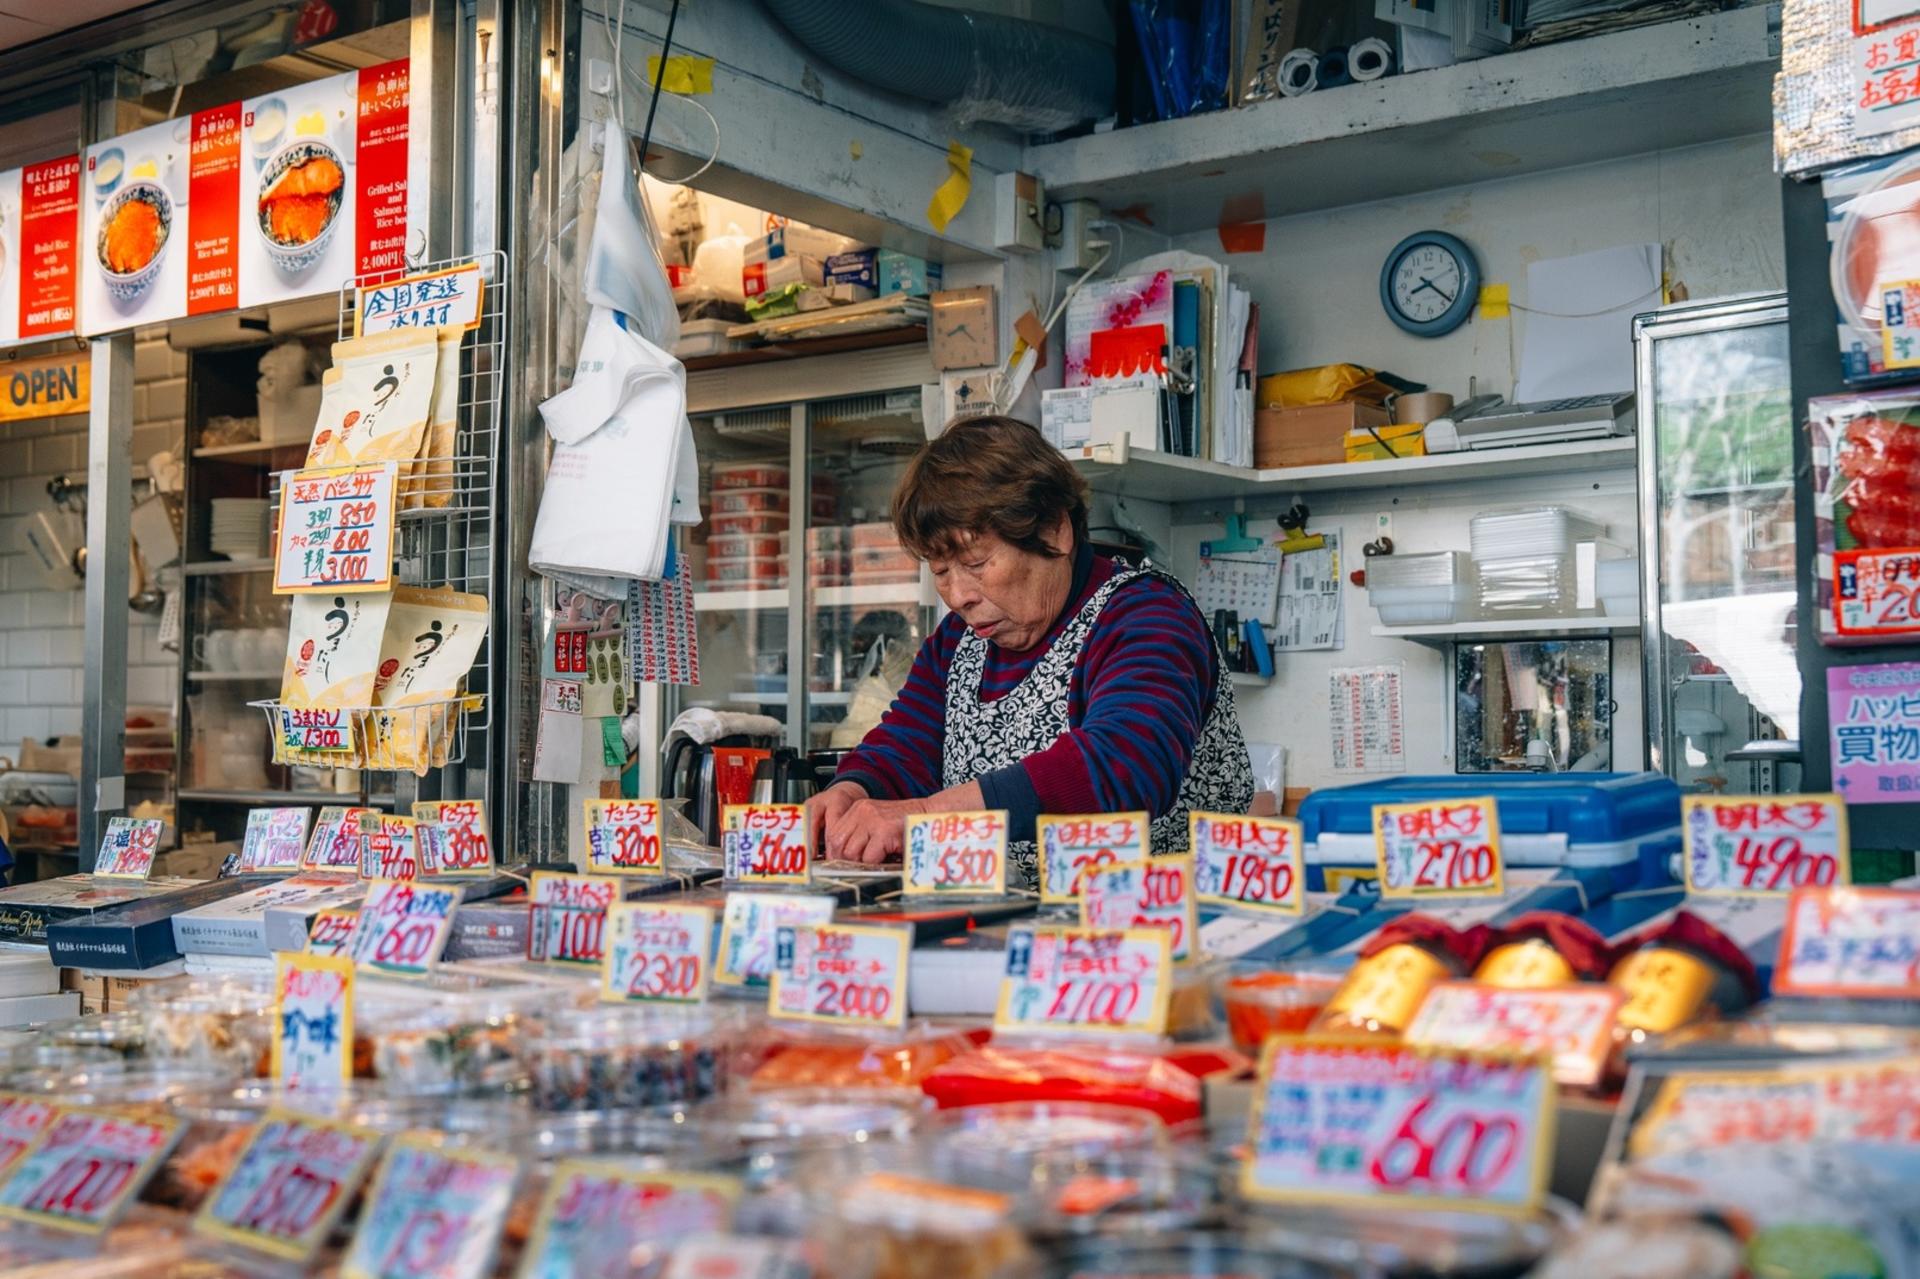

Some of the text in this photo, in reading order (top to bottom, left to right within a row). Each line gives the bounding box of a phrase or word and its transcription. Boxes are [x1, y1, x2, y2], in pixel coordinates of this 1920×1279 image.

[376, 76, 410, 96] 魚卵屋
[368, 184, 393, 196] Grilled
[388, 194, 403, 204] and
[374, 207, 402, 217] Salmon
[377, 217, 393, 228] Rice
[365, 275, 458, 318] 全国発送
[10, 366, 78, 407] OPEN
[294, 483, 321, 502] 天然
[340, 502, 376, 527] 850
[333, 529, 370, 550] 600
[292, 708, 341, 728] うまだし
[1838, 724, 1920, 764] 買物
[440, 802, 480, 825] たら子
[605, 802, 658, 825] たら子
[744, 806, 802, 831] たら子
[1398, 804, 1482, 840] 明太子
[1713, 801, 1827, 833] 明太子
[930, 815, 1005, 845] 明太子
[1058, 819, 1135, 846] 明太子
[1210, 820, 1289, 856] 明太子
[589, 825, 605, 865] 古平
[739, 832, 753, 876] 古平
[376, 915, 435, 965] 600
[1368, 1090, 1521, 1197] 600
